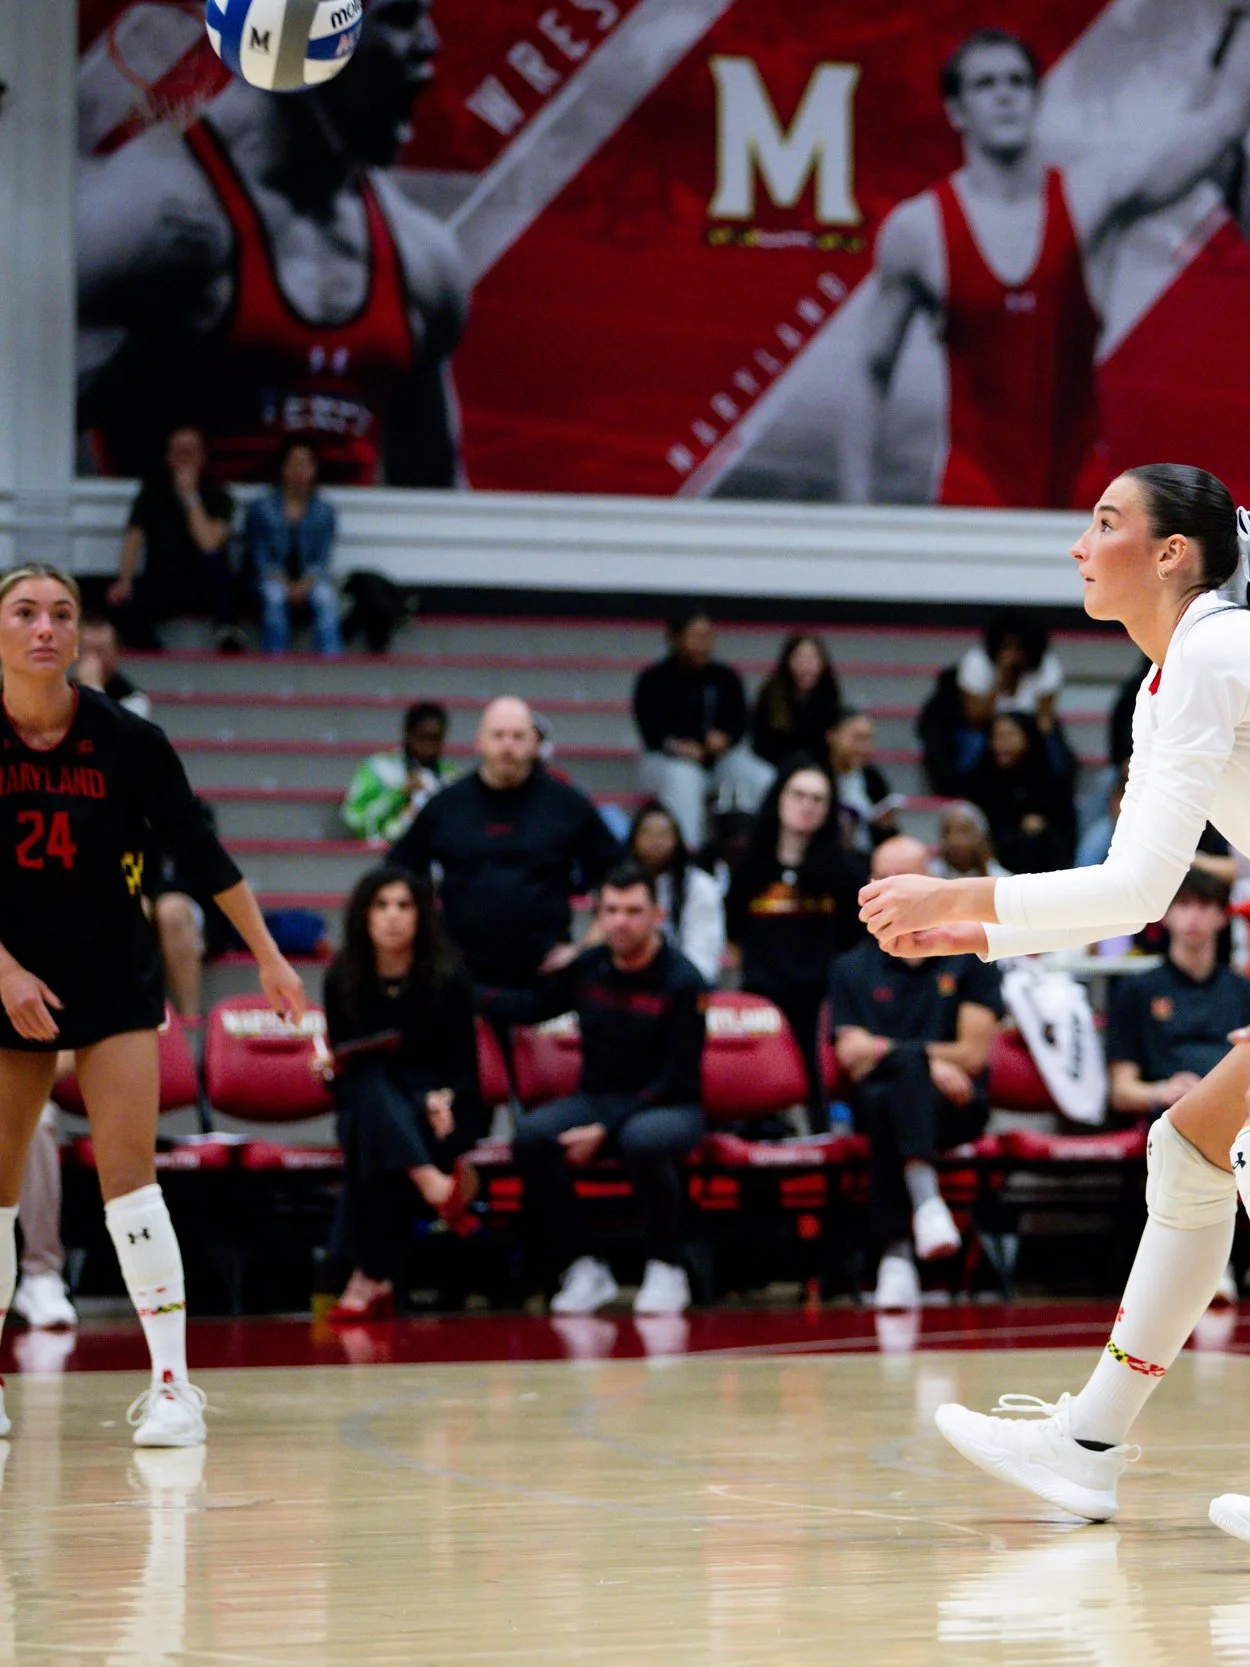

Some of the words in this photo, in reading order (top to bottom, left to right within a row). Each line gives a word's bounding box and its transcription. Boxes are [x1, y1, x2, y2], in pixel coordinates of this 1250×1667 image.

[250, 27, 272, 53] M
[707, 54, 863, 227] M
[16, 810, 77, 869] 24
